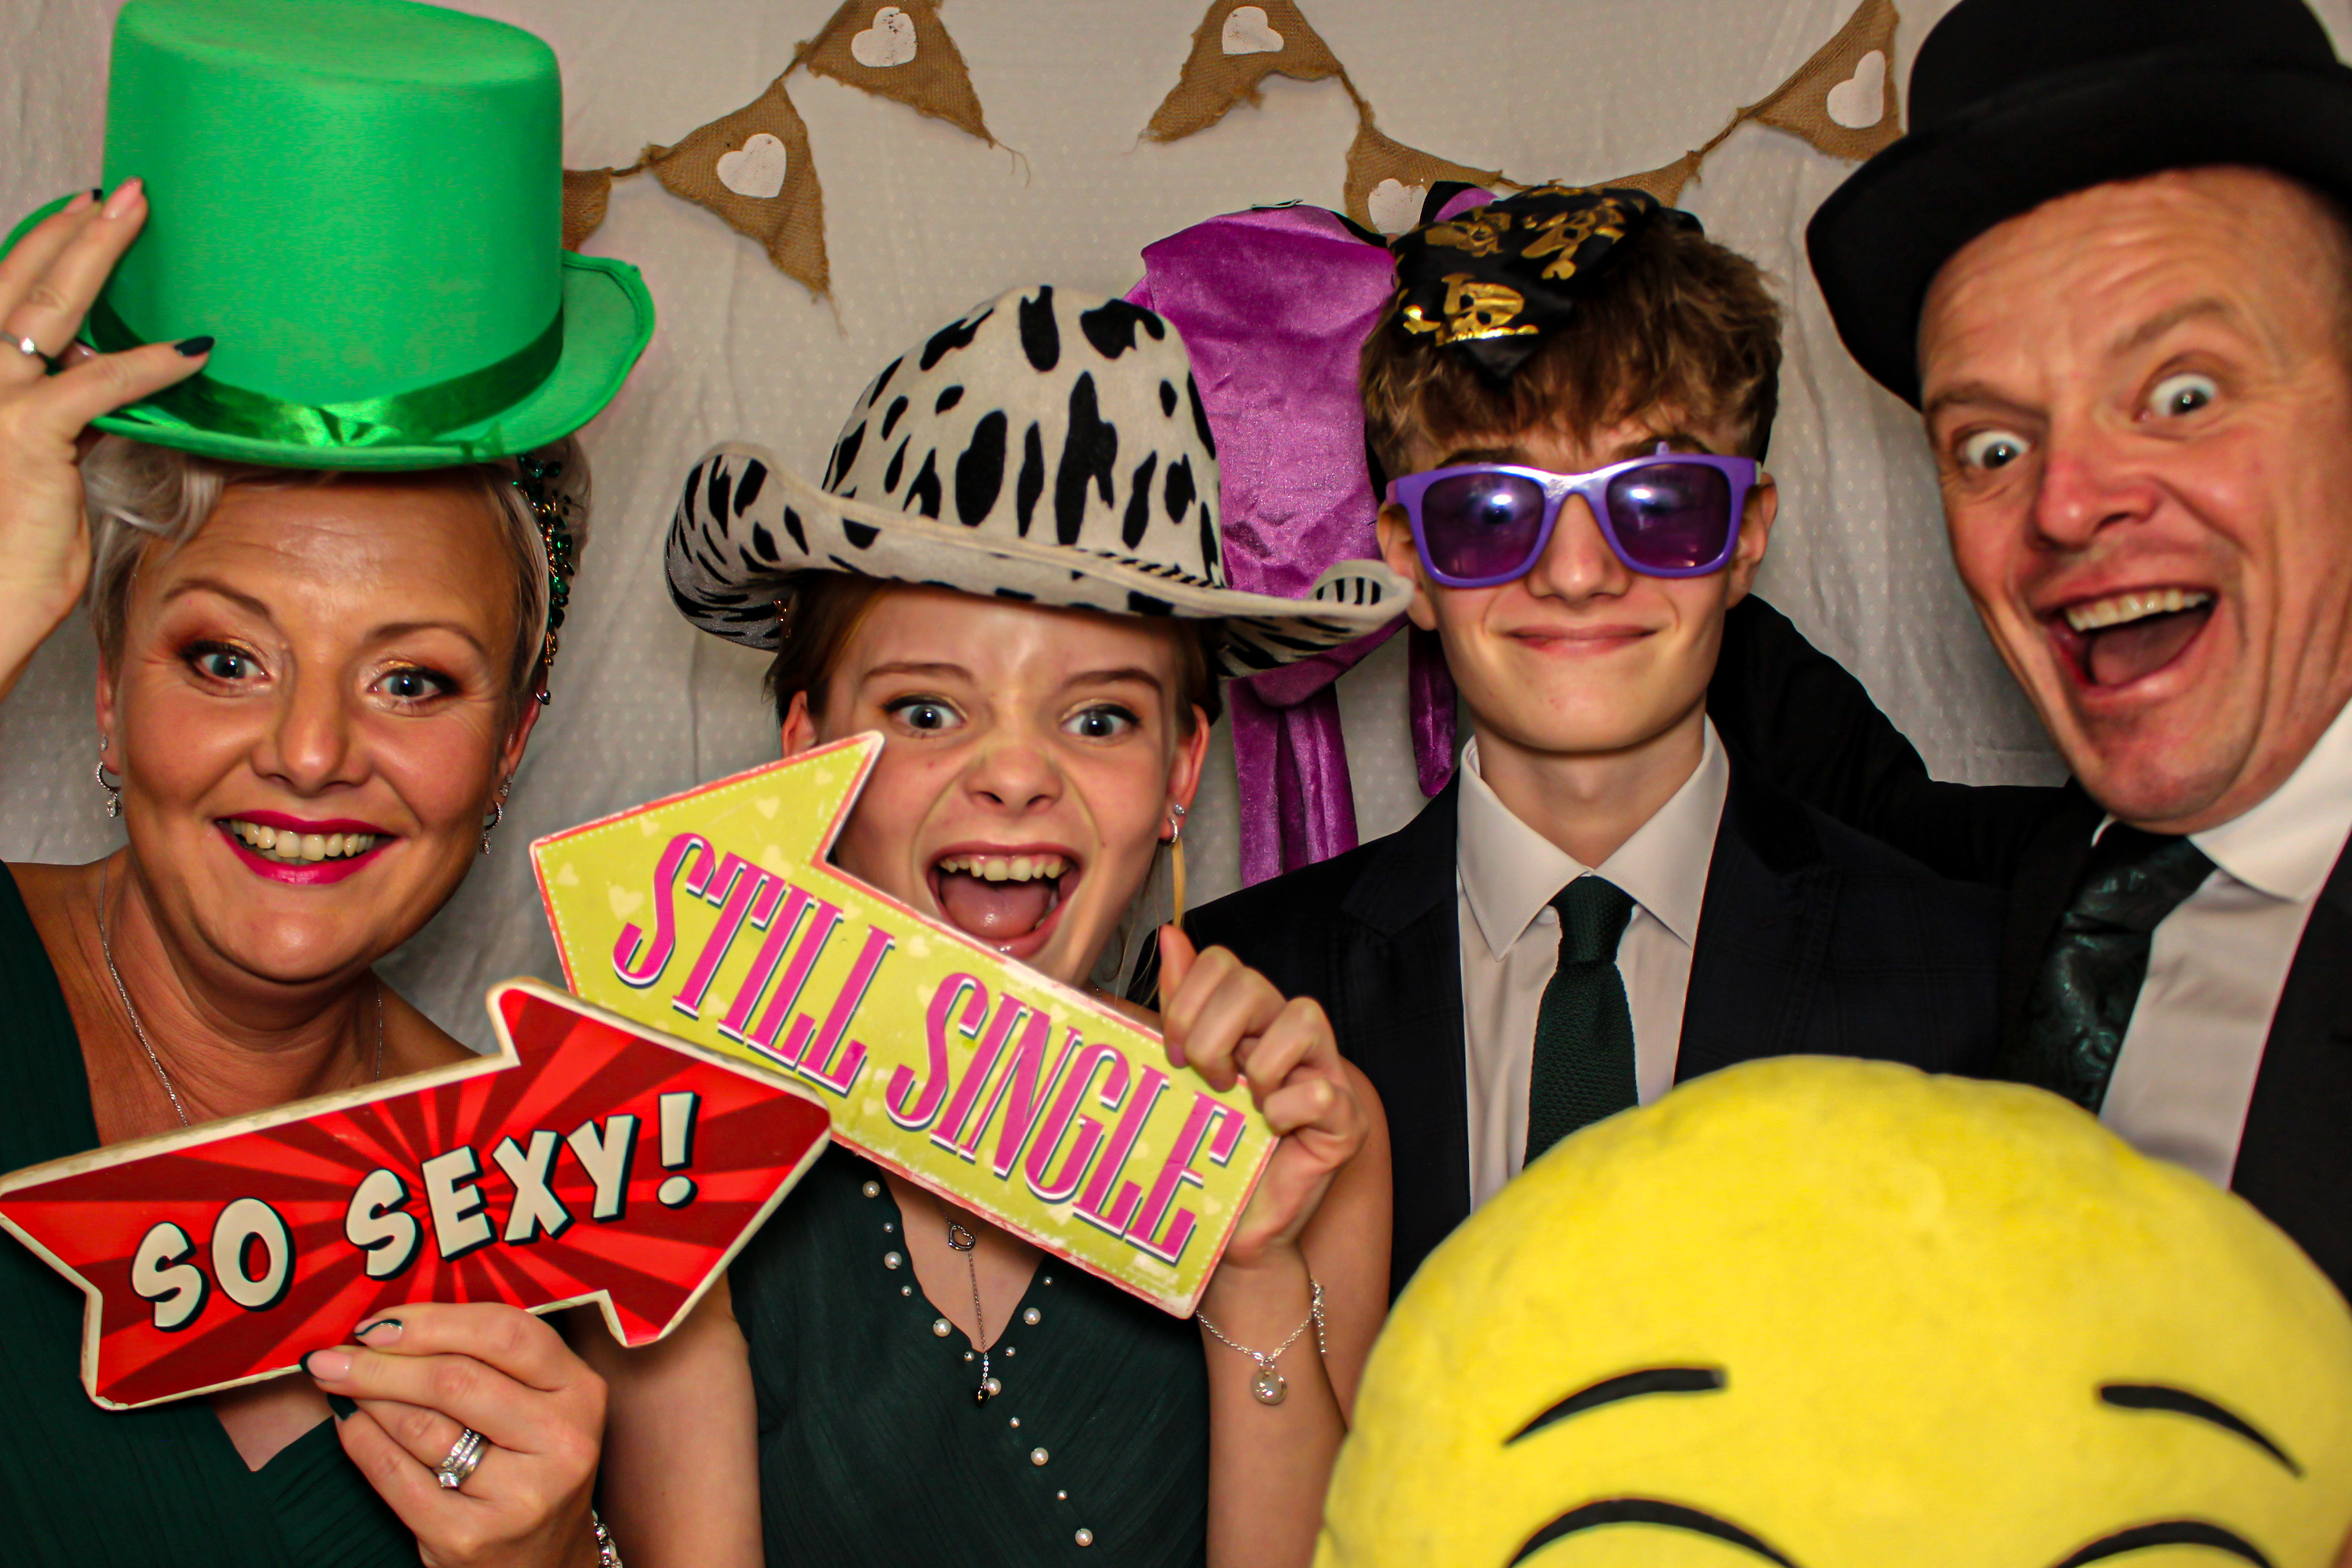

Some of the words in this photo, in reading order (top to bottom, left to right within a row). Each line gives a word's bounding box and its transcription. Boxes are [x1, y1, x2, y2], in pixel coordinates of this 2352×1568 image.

[130, 1197, 298, 1333] SO
[345, 1091, 701, 1281] SEXY!
[612, 832, 896, 1096] STILL
[884, 972, 1247, 1265] SINGLE
